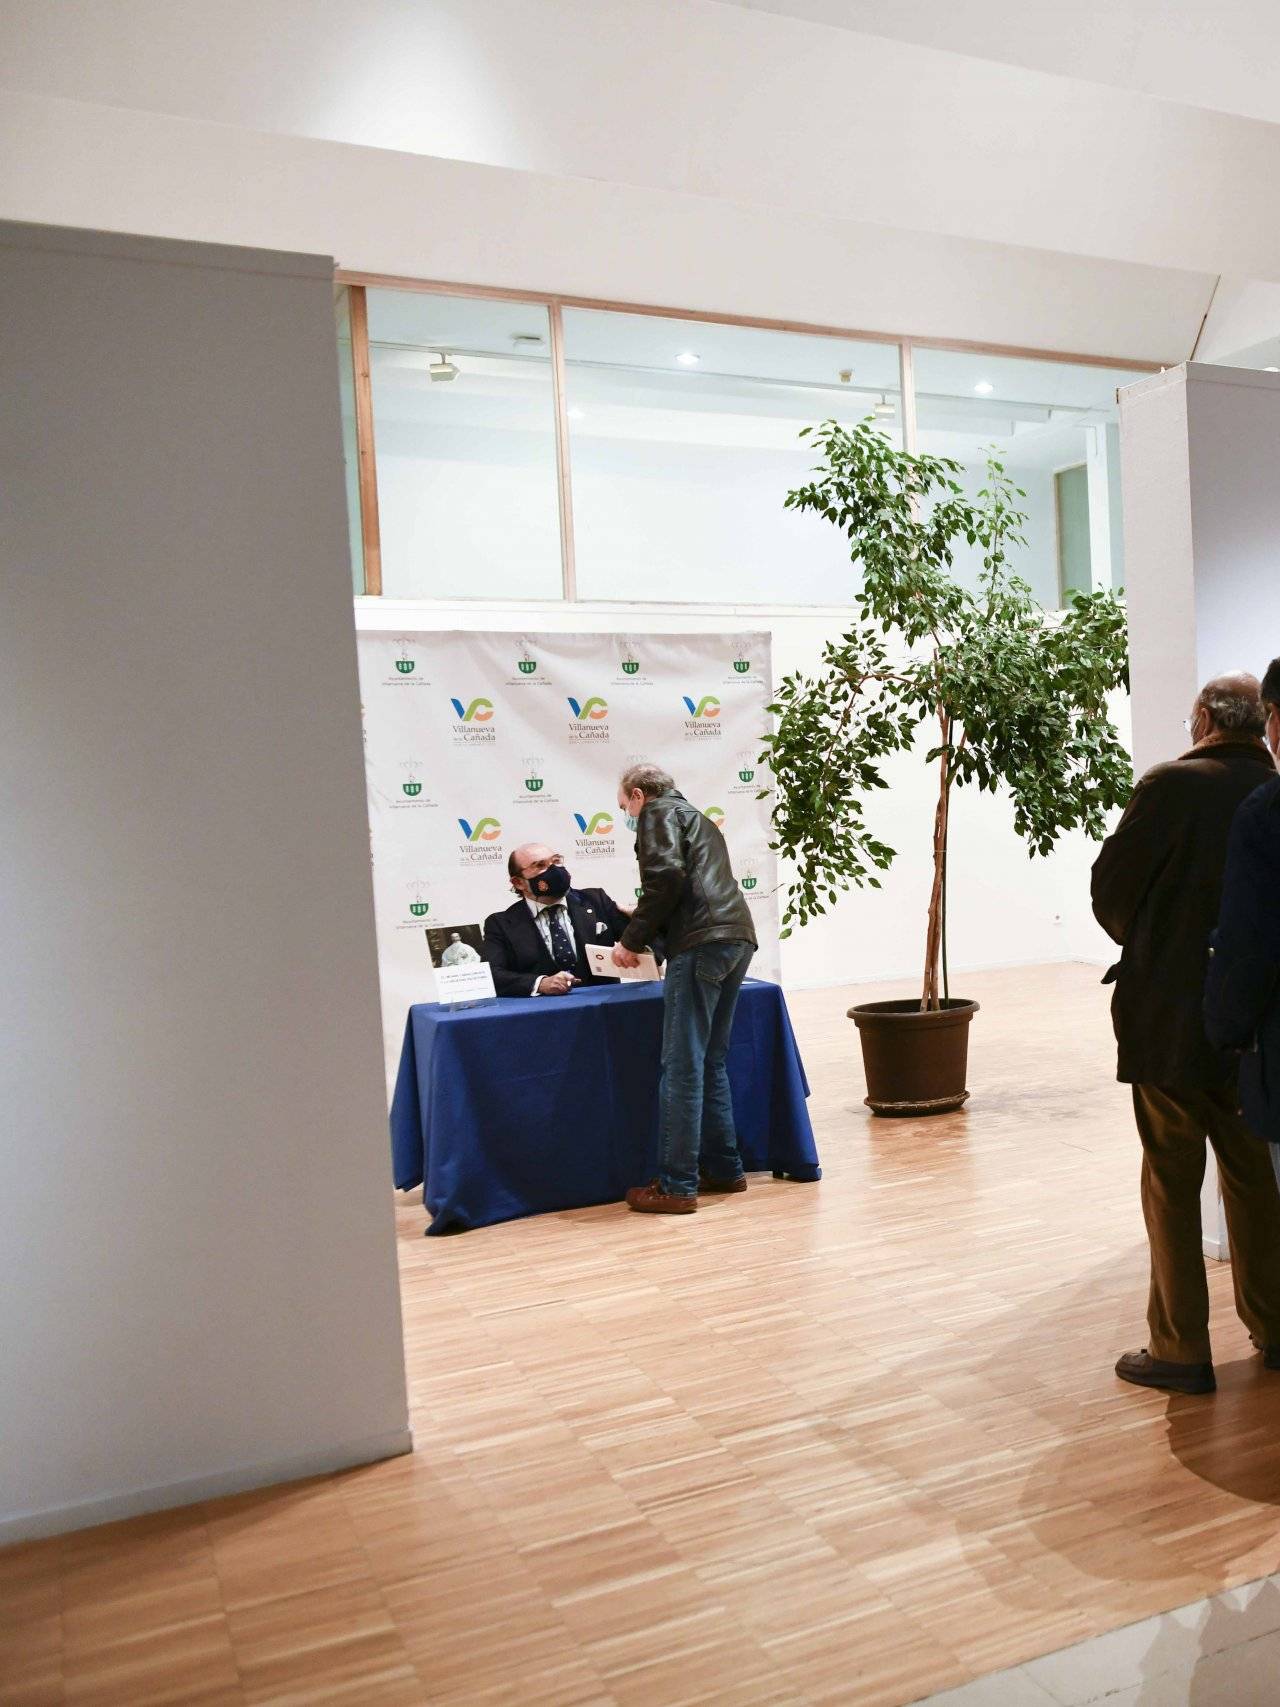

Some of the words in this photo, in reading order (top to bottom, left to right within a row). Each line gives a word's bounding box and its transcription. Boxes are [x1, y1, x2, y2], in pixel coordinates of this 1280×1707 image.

[452, 725, 495, 734] Villanueva
[568, 723, 609, 731] Villanueva
[684, 721, 721, 729] Villanueva
[463, 733, 496, 741] Cañada
[578, 730, 610, 739] Cañada
[575, 839, 615, 847] Villanueva
[459, 845, 502, 854] Villanueva
[585, 846, 616, 855] Cañada
[470, 852, 503, 861] Cañada
